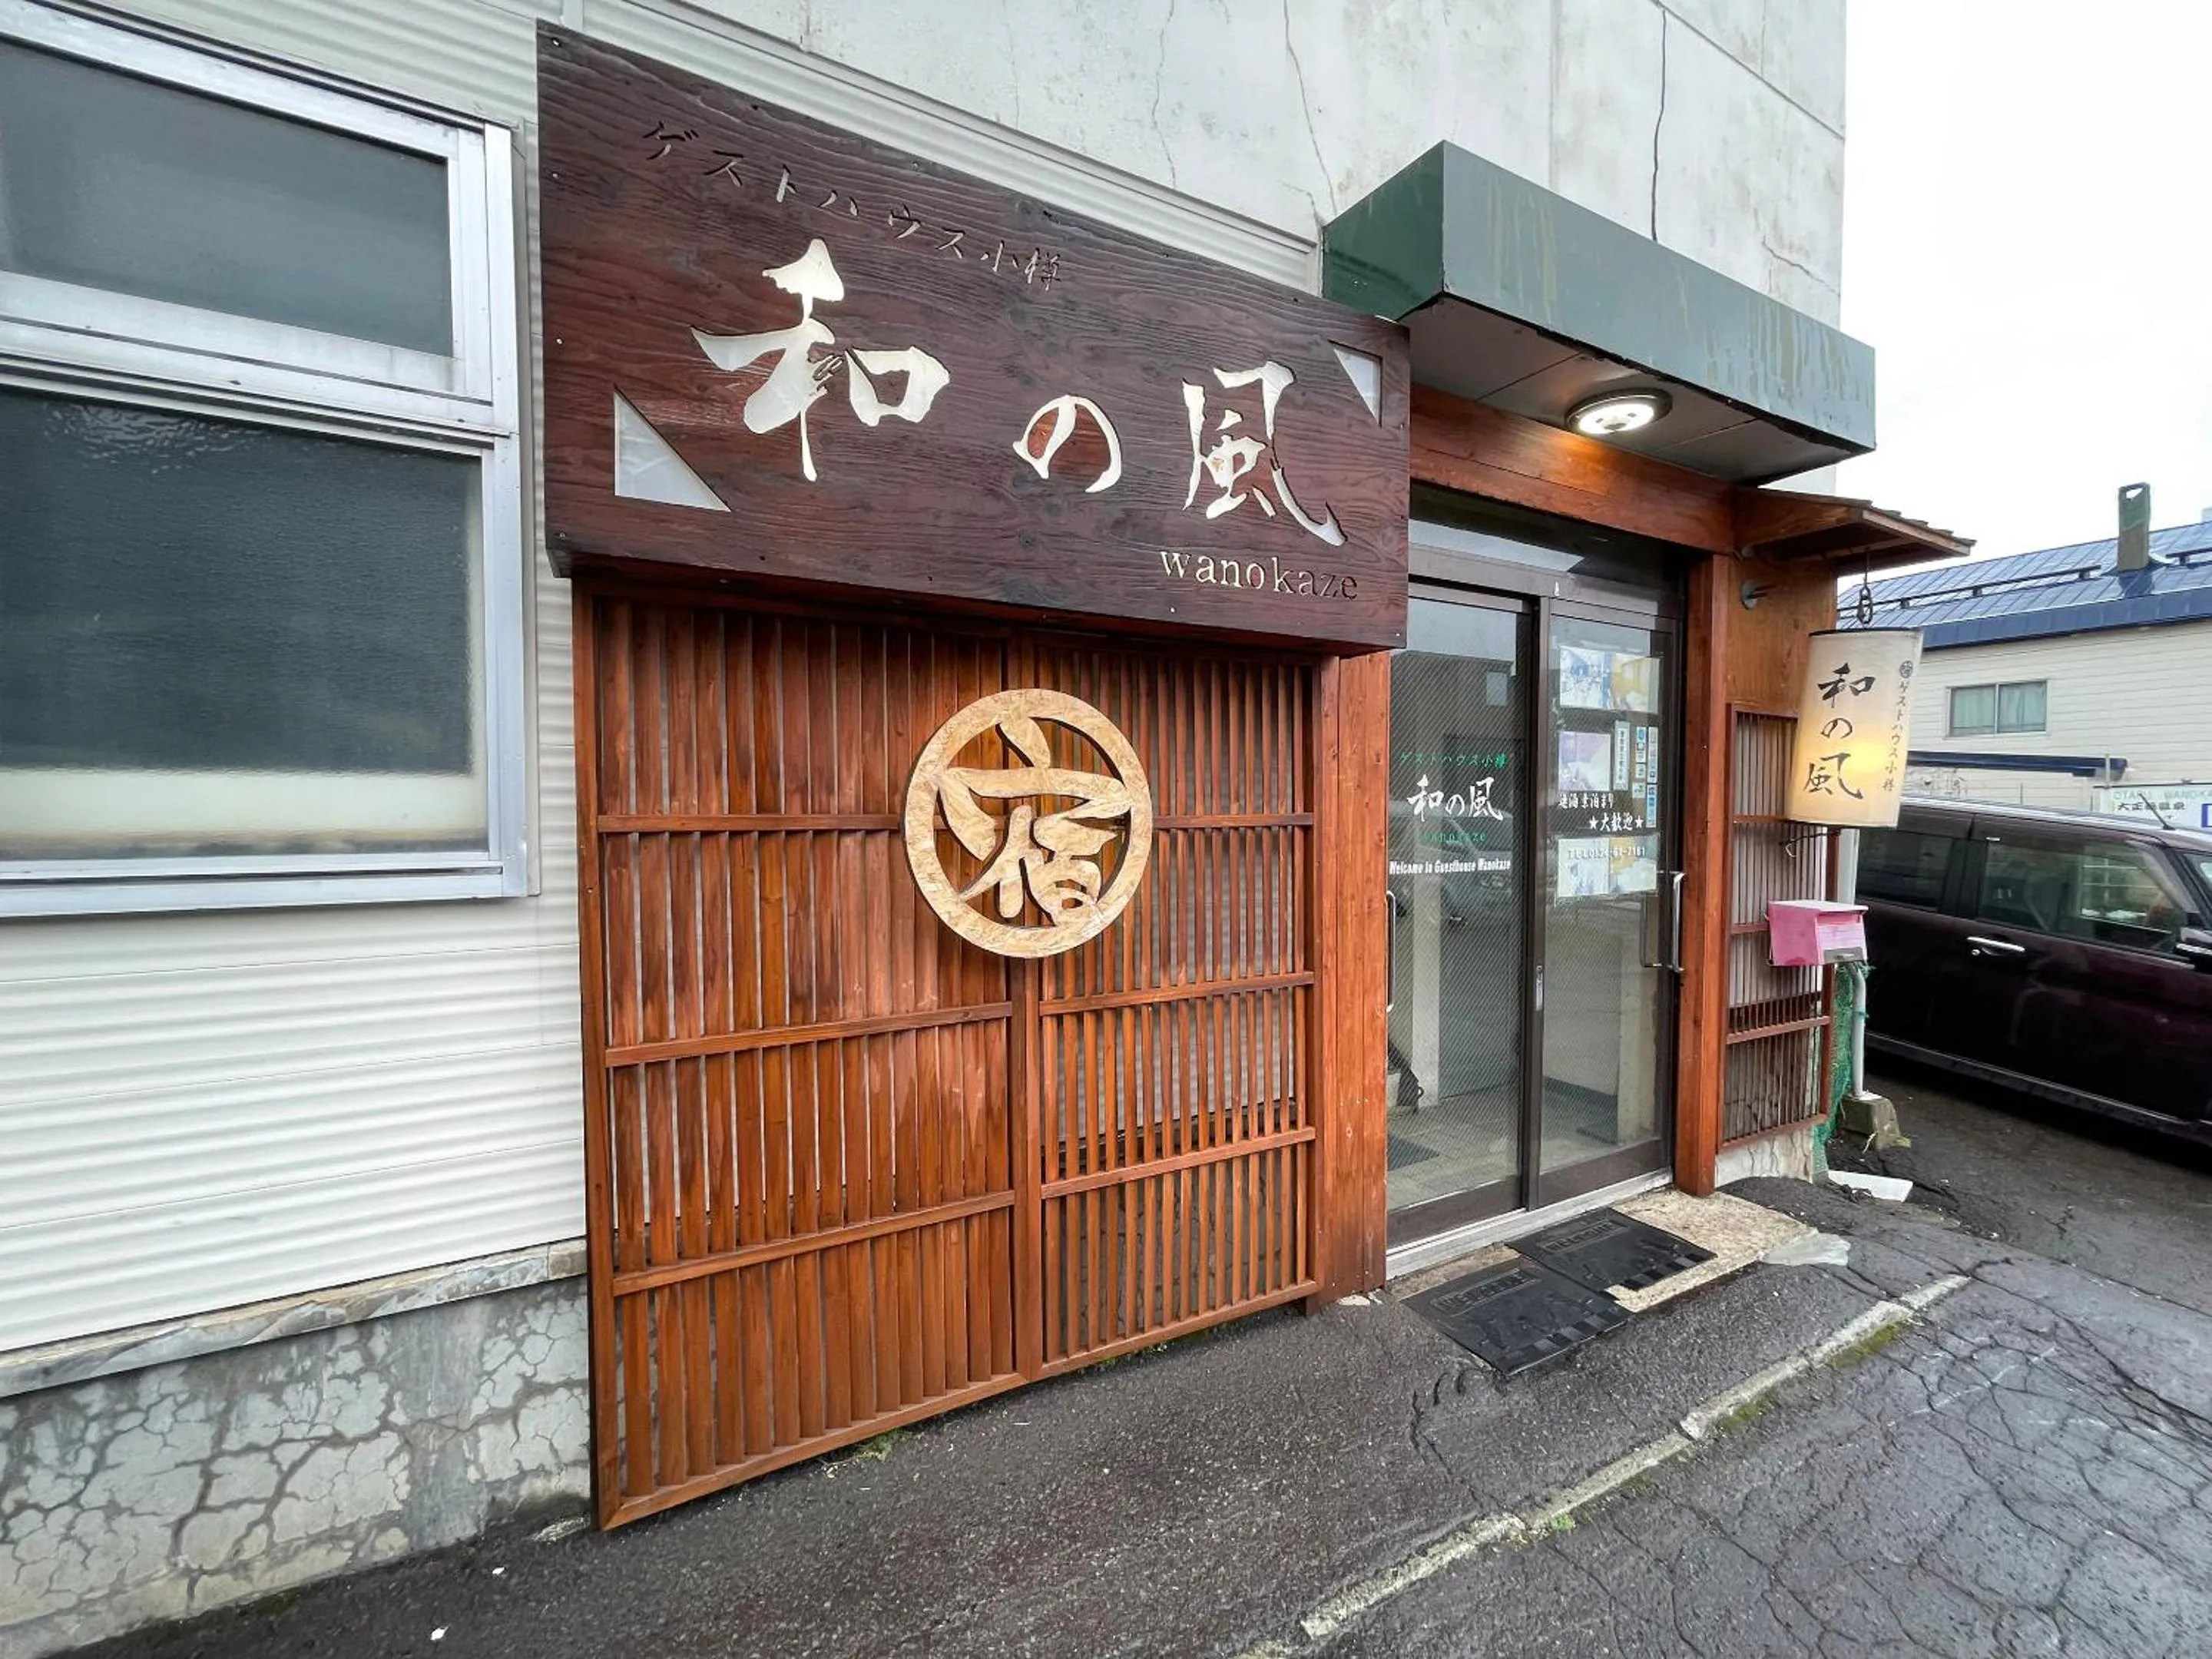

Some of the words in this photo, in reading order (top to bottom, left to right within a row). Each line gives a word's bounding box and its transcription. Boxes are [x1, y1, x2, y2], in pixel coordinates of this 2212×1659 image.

[642, 120, 1062, 293] ゲストハウス小樽
[689, 237, 1349, 548] 和の風
[1159, 550, 1358, 600] wanokaze
[1406, 773, 1503, 823] 和の風
[1803, 662, 1876, 800] 和の風
